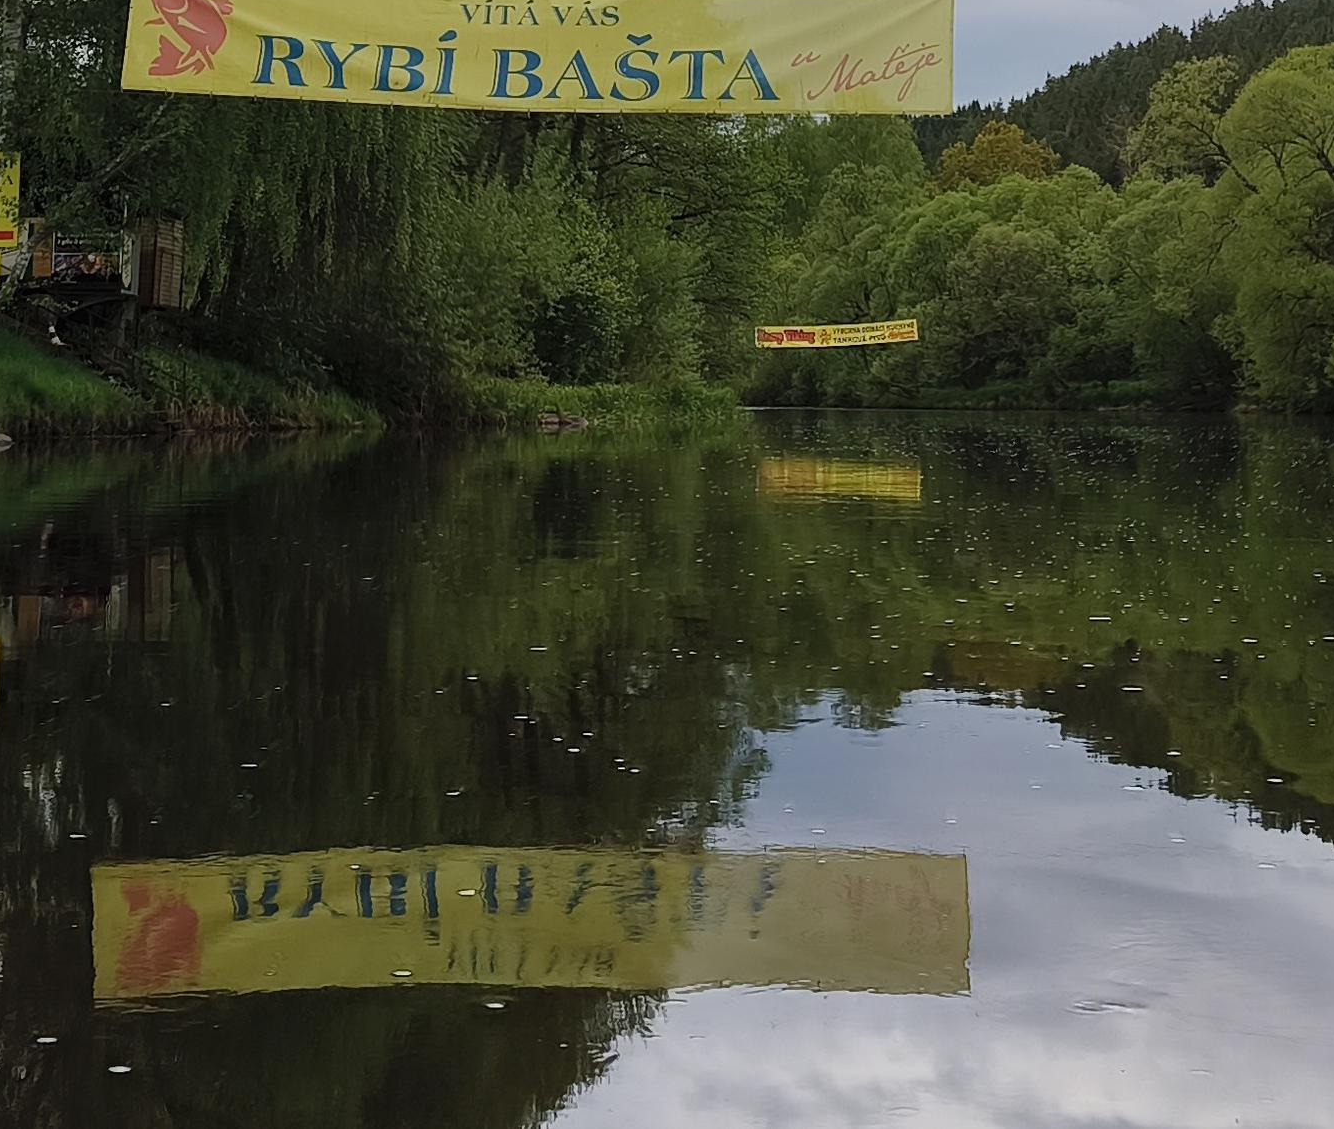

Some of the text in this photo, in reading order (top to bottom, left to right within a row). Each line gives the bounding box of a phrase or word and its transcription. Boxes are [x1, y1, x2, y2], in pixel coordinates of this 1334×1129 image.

[551, 0, 620, 27] VÁS
[250, 29, 781, 101] RYBÍ BAŠTA
[791, 43, 943, 102] u Matěje
